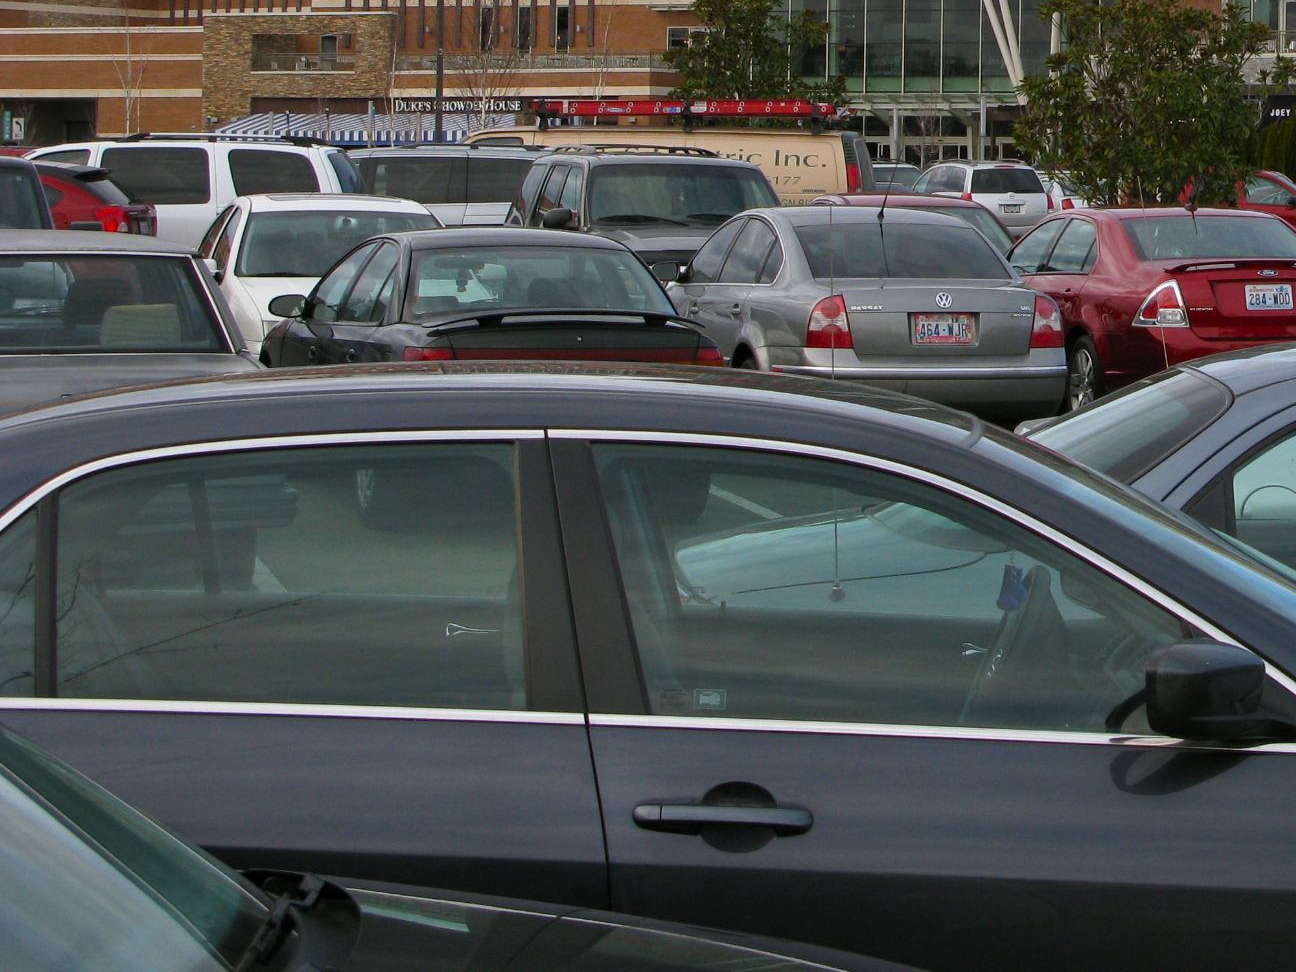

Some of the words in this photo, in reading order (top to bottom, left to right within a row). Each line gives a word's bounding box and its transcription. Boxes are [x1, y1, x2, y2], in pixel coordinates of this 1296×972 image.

[395, 99, 432, 112] DUKE'S
[486, 98, 522, 111] HOUSE
[1269, 108, 1291, 117] JOEY
[774, 149, 827, 168] Inc.
